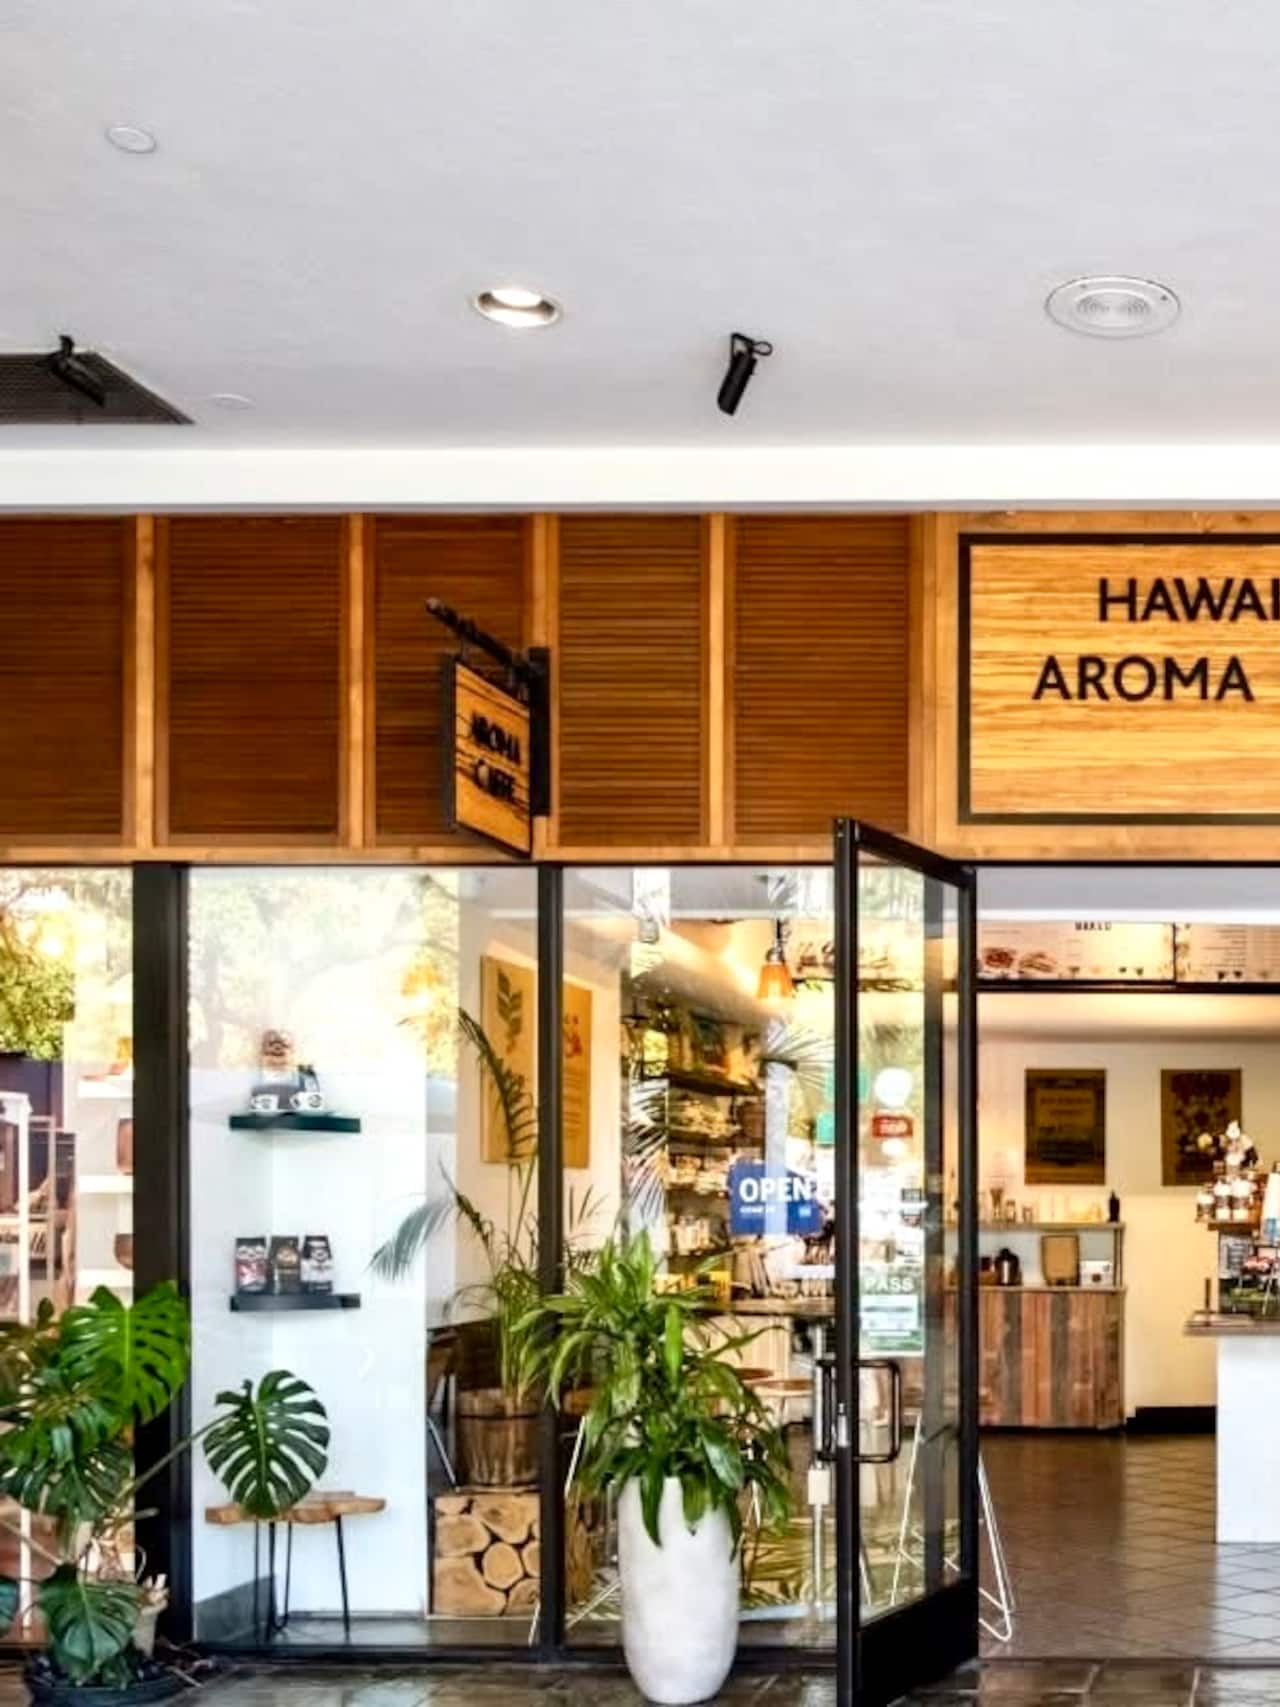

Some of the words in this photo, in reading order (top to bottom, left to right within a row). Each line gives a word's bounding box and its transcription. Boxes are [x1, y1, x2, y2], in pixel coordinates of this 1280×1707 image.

[1032, 655, 1255, 702] AROMA
[739, 1177, 812, 1202] OPEN
[863, 1278, 914, 1293] PASS
